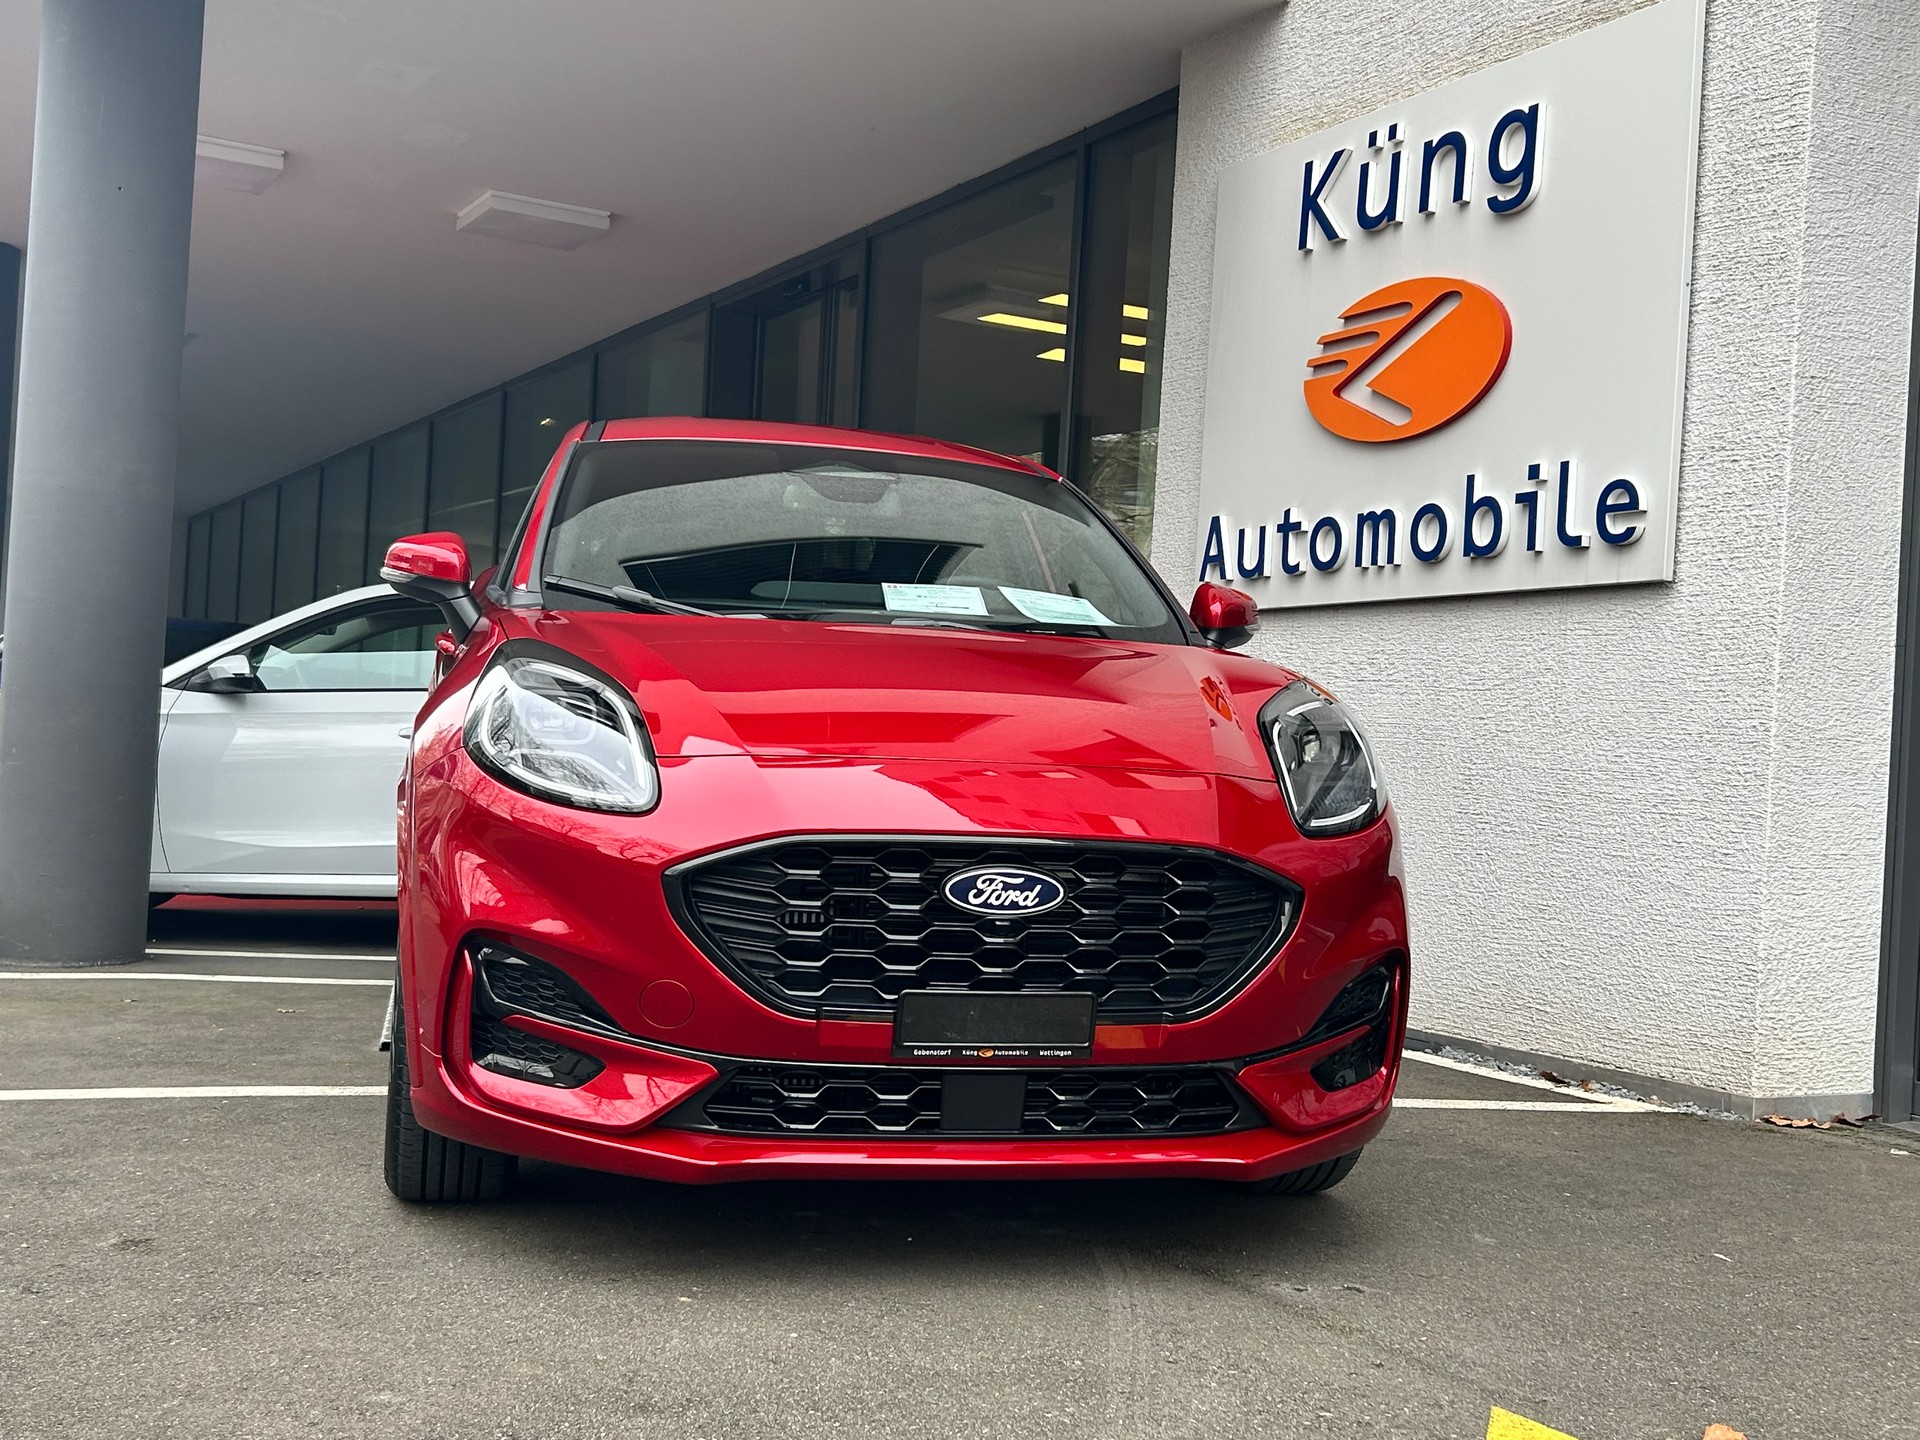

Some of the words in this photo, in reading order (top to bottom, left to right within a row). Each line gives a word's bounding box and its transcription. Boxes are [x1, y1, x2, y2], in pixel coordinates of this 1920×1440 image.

[1298, 103, 1545, 251] Küng
[1199, 460, 1646, 583] Automobile
[968, 874, 1042, 907] Ford
[962, 1049, 978, 1057] Küng
[1039, 1049, 1072, 1057] Wettingen
